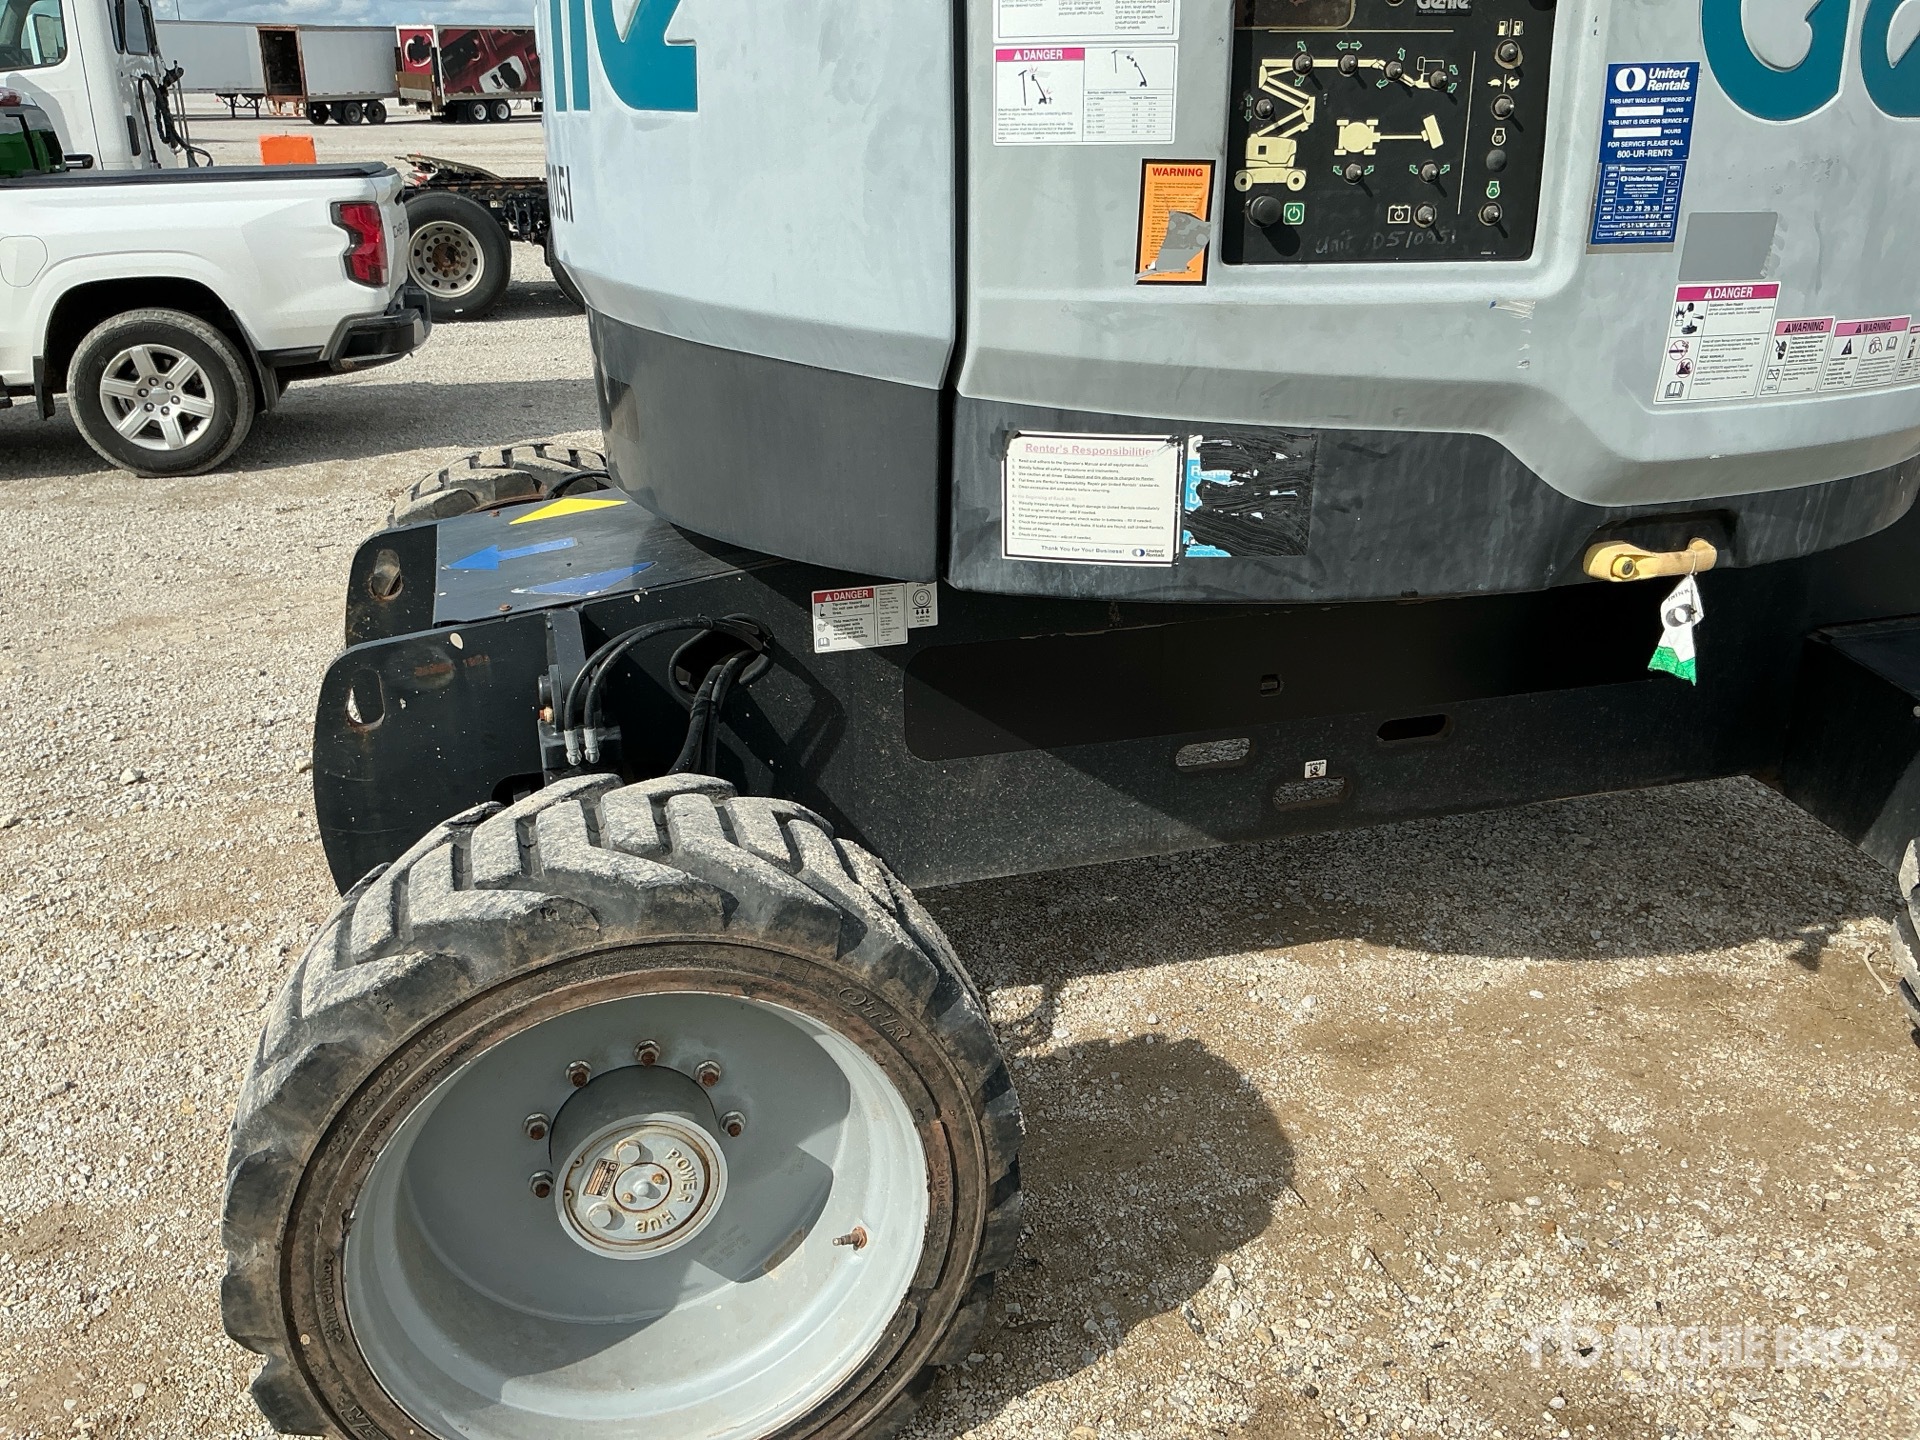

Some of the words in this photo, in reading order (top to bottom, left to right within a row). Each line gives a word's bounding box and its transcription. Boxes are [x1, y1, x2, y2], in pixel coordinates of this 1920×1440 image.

[1024, 50, 1063, 60] DANGER
[1649, 67, 1690, 79] United
[1647, 79, 1690, 91] Rentals
[1616, 148, 1673, 158] 800-UR-RENTS
[1152, 168, 1203, 176] WARNING
[1713, 286, 1754, 299] DANGER
[1791, 321, 1824, 333] WARNING
[1862, 322, 1891, 332] WARNING
[1026, 444, 1069, 454] Renter's
[834, 590, 868, 600] DANGER
[1668, 588, 1690, 602] THINK
[414, 1028, 447, 1058] NHS
[665, 1148, 698, 1204] POWER
[634, 1210, 677, 1234] HUB
